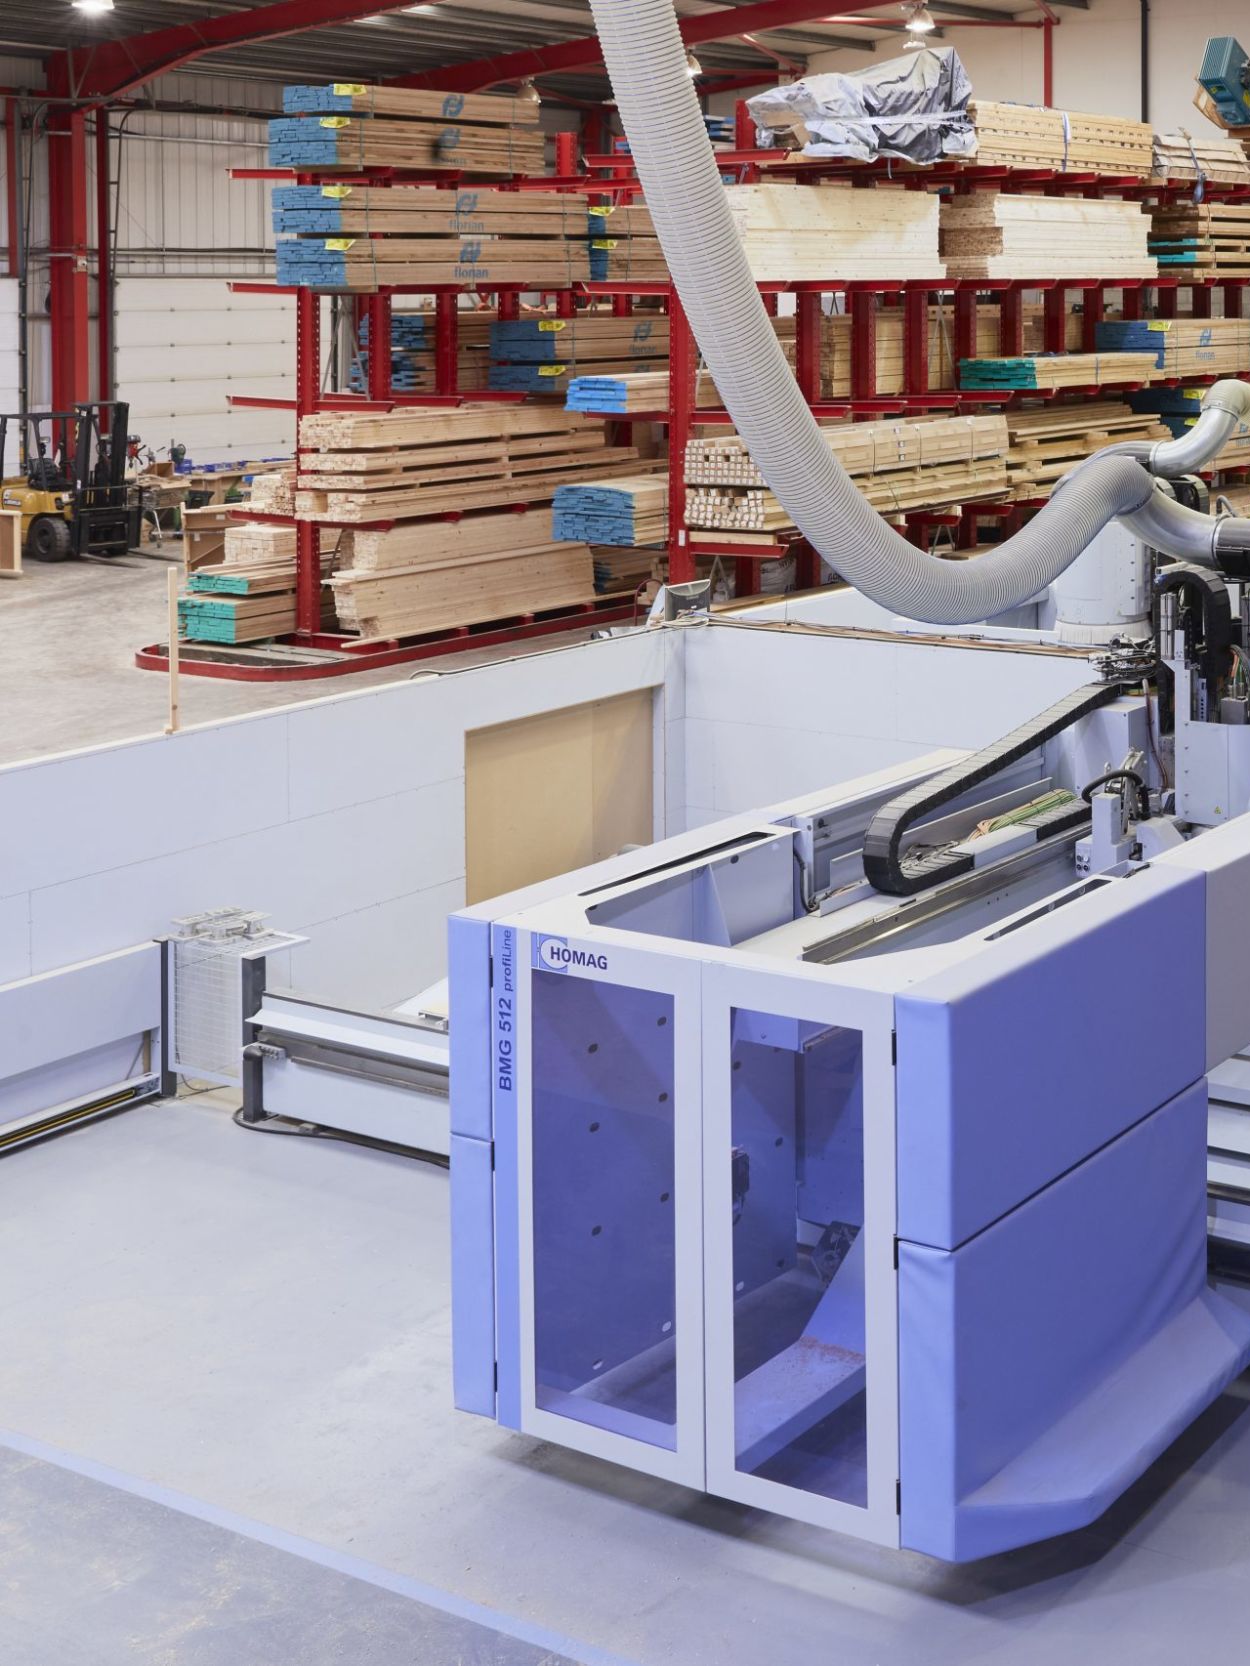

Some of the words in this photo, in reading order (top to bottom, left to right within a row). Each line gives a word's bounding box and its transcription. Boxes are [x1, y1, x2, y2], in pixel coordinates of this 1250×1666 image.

[502, 929, 514, 992] profiLine
[550, 946, 608, 970] HOMAG
[498, 997, 512, 1032] 512
[498, 1039, 513, 1091] BMG
